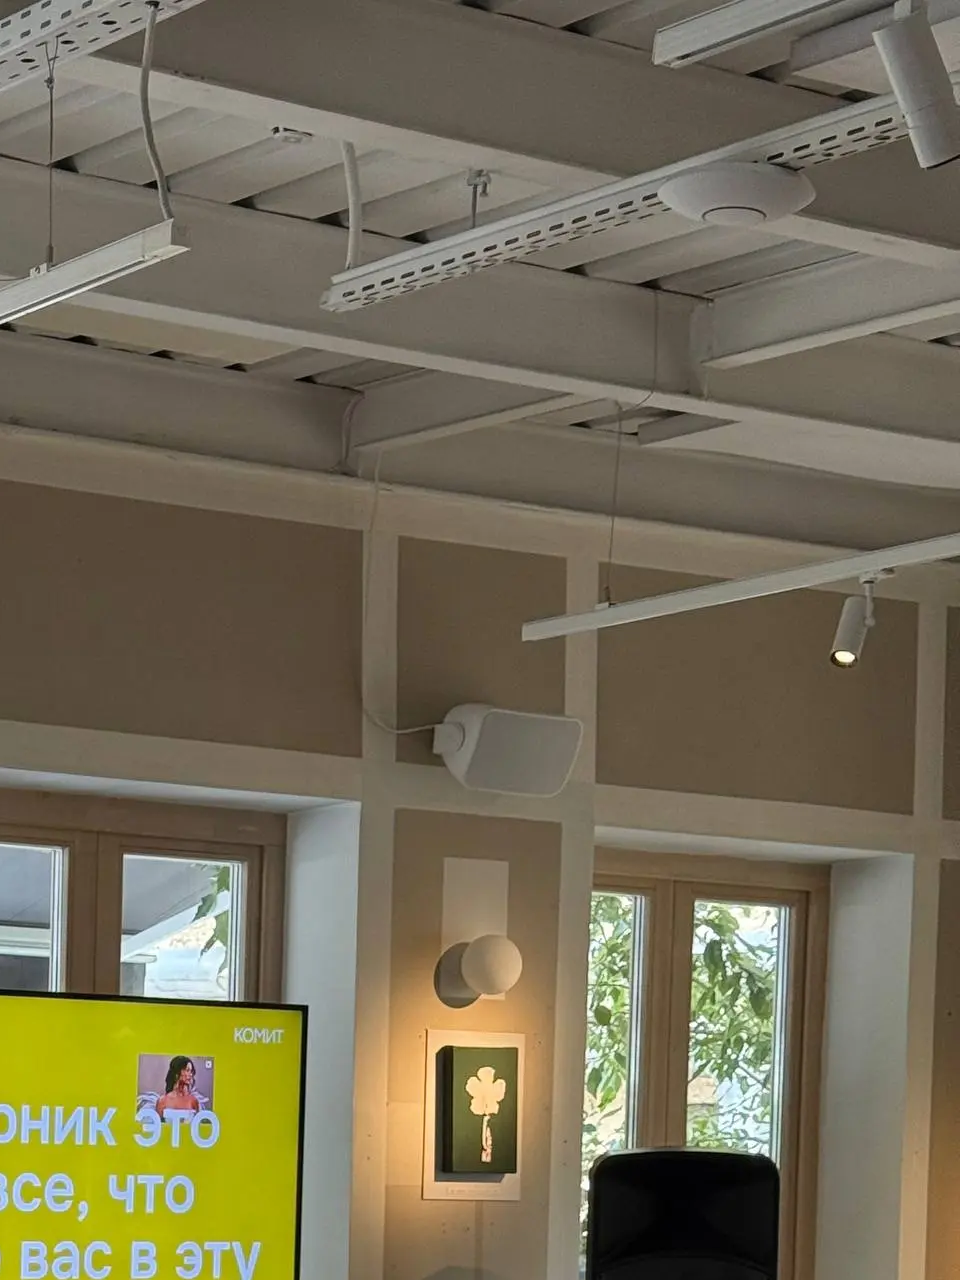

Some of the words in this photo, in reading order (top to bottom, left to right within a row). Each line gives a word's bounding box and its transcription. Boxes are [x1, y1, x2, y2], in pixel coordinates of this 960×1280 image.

[234, 1027, 284, 1044] КОМИТ
[133, 1107, 221, 1148] это
[108, 1174, 196, 1214] что
[20, 1240, 113, 1280] вас
[130, 1240, 158, 1280] в
